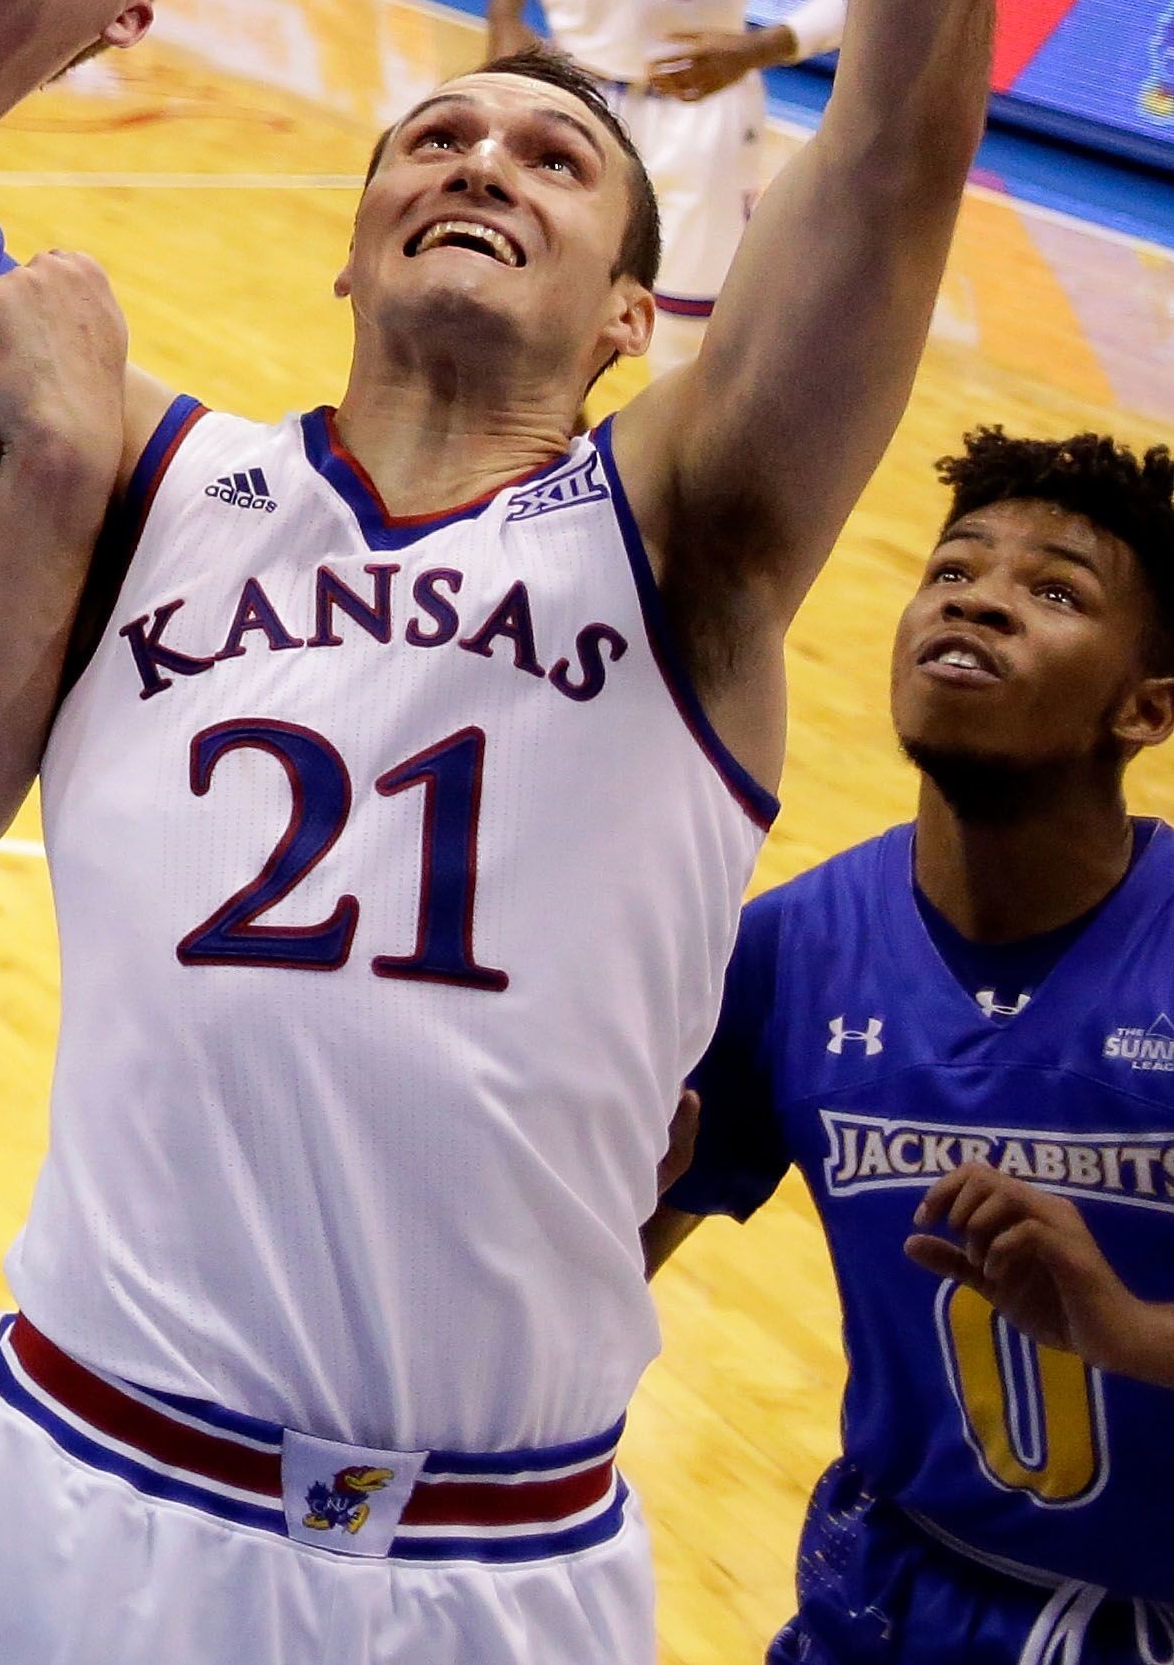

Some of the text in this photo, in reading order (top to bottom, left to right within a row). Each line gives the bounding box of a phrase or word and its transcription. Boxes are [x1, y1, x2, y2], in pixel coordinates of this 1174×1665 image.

[204, 484, 279, 514] adidas
[119, 563, 629, 702] KANSAS
[176, 716, 510, 992] 21
[1104, 1036, 1174, 1060] SUM
[1116, 1027, 1146, 1037] THE
[933, 1277, 1111, 1510] 0
